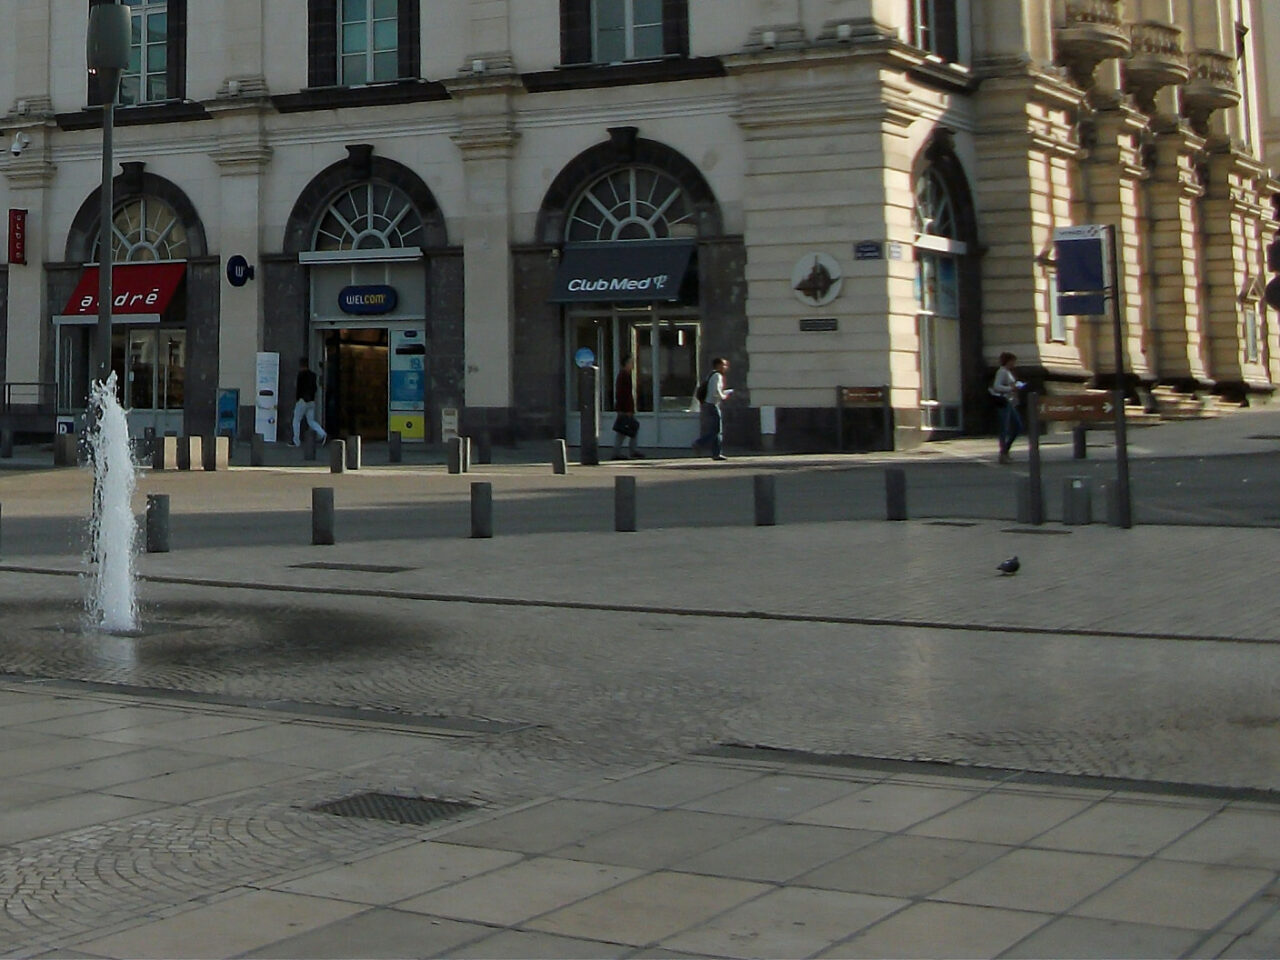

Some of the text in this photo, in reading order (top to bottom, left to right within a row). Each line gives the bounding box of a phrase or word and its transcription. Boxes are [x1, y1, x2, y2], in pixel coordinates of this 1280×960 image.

[567, 277, 651, 291] Club Med
[79, 288, 160, 311] adré
